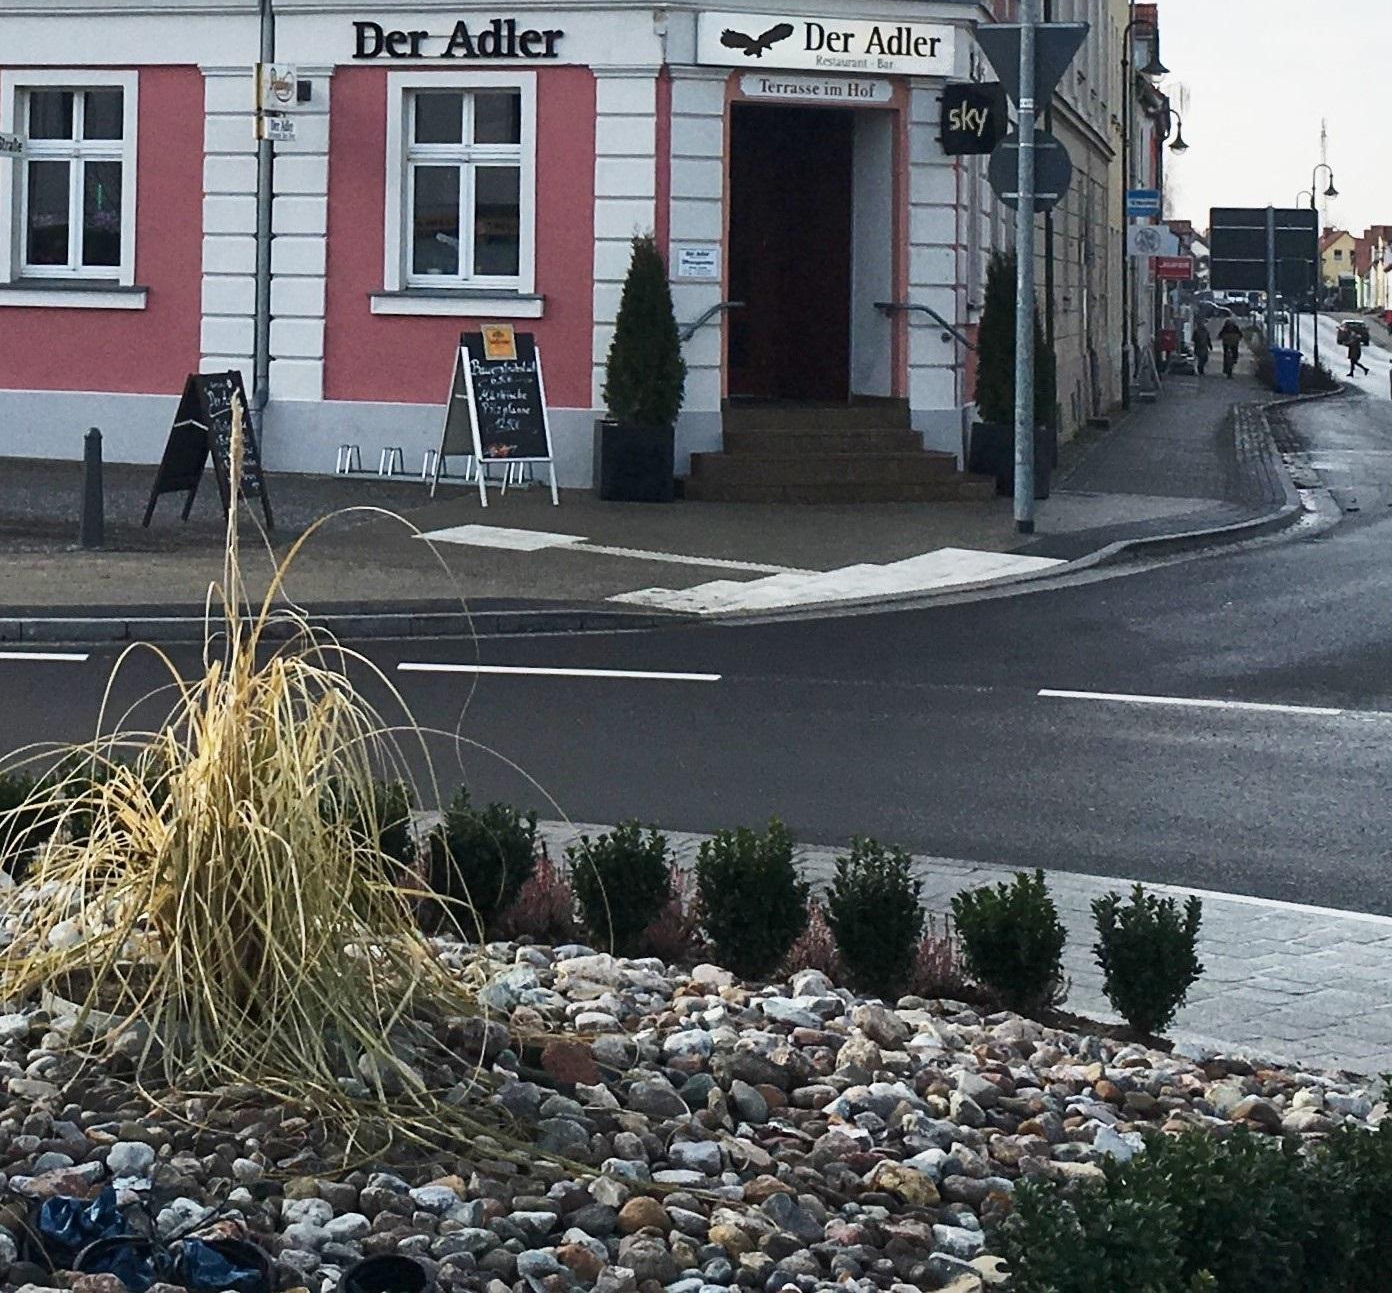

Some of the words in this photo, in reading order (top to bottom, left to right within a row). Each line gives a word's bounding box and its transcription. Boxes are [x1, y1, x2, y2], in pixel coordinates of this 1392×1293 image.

[352, 21, 429, 58] Der
[441, 19, 564, 58] Adler
[804, 22, 855, 53] Der
[865, 26, 941, 58] Adler
[816, 55, 868, 69] Restaurant
[877, 60, 894, 69] Bar
[759, 79, 820, 95] Terrasse
[824, 81, 843, 97] im
[848, 83, 877, 98] Hof
[949, 100, 988, 137] sky
